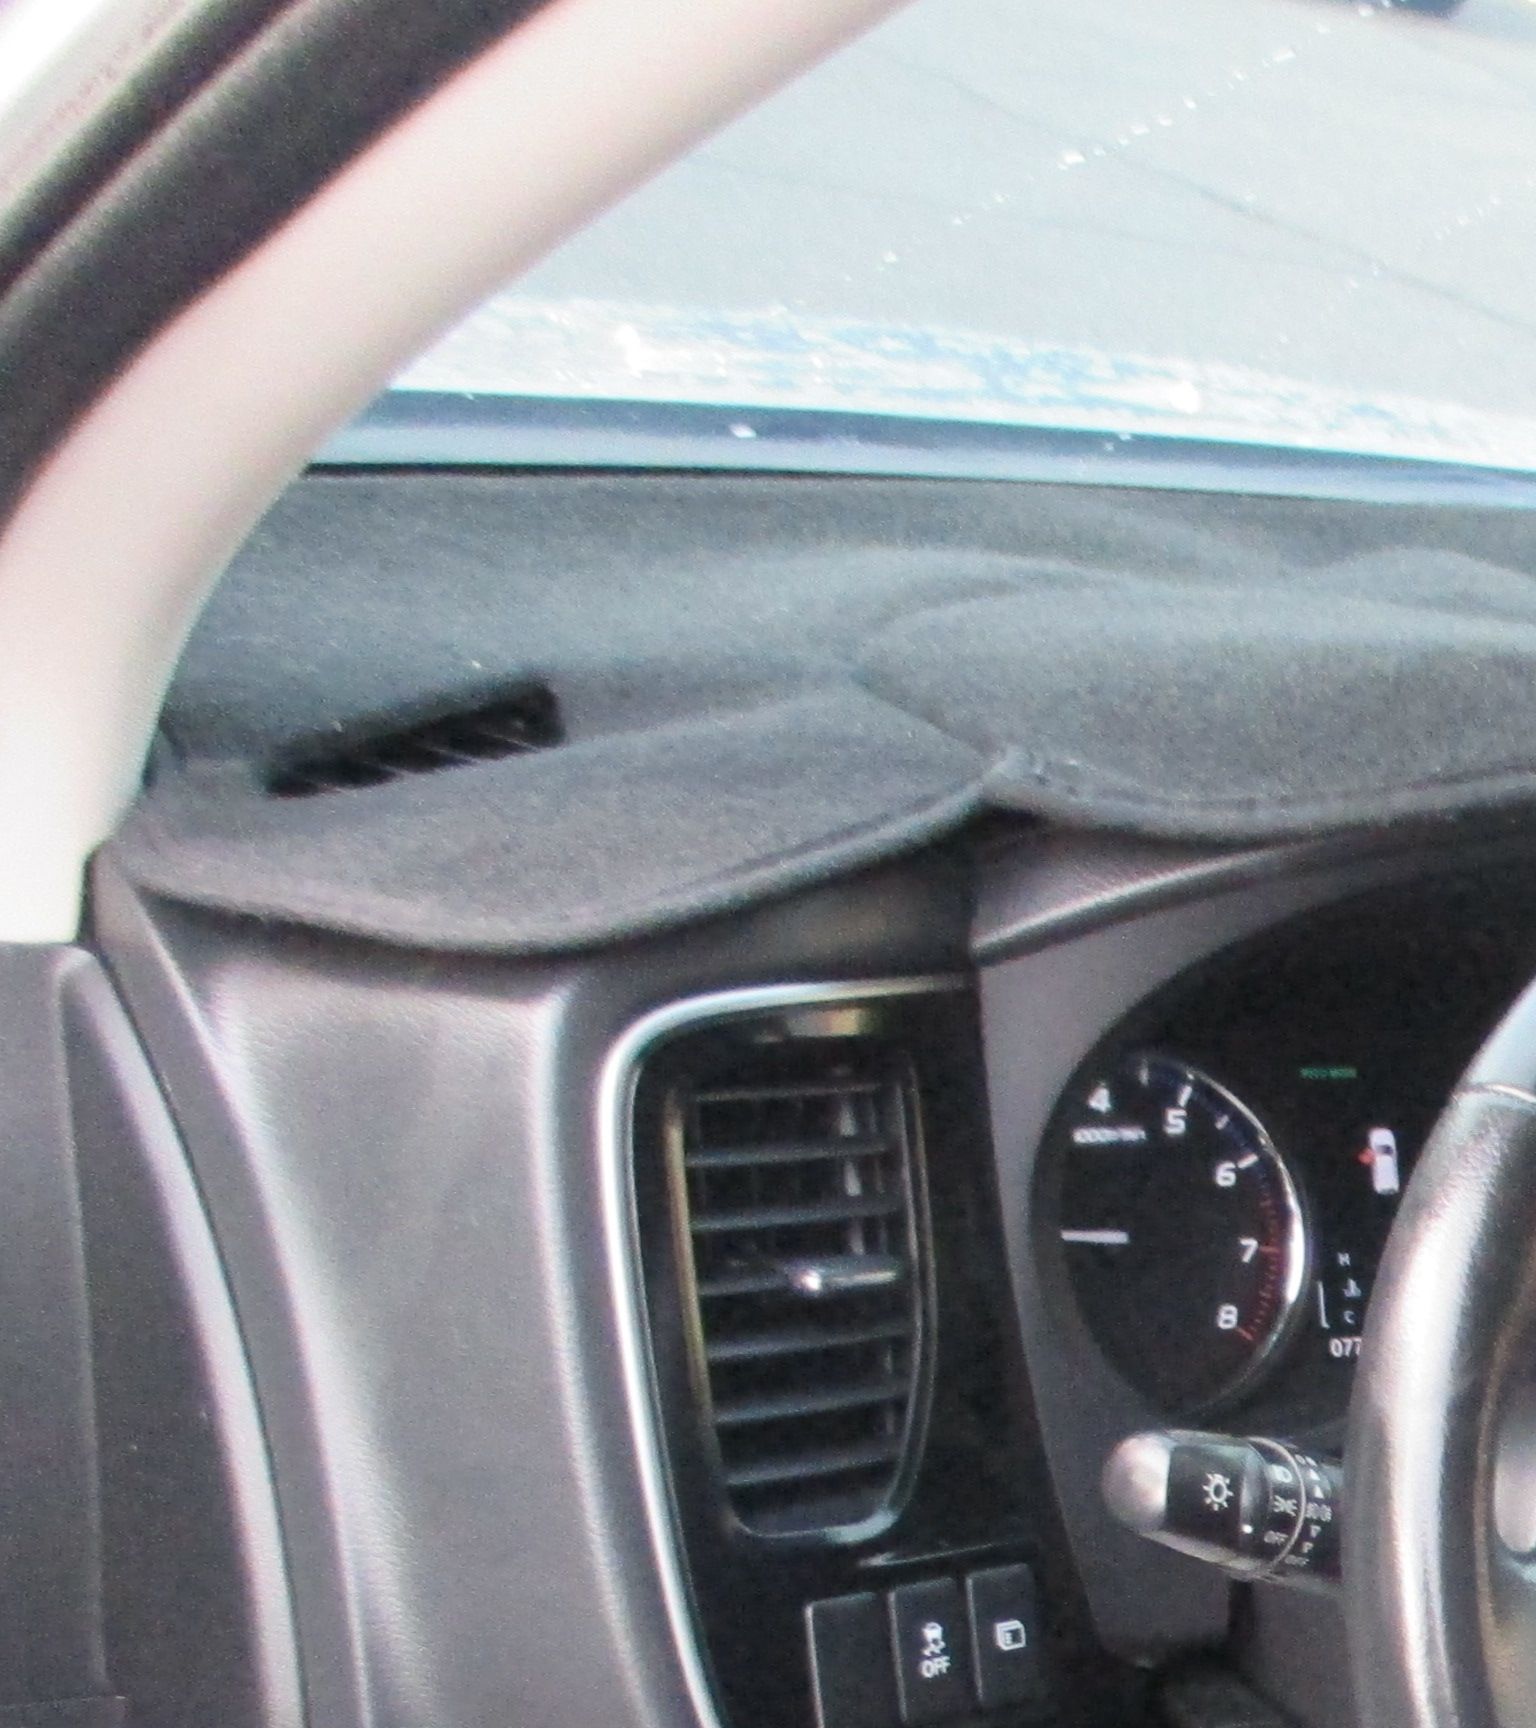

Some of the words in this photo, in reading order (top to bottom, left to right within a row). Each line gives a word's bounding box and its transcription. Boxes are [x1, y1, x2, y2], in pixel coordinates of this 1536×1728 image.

[1087, 1086, 1111, 1113] 4
[1163, 1108, 1187, 1135] 5
[1215, 1163, 1236, 1187] 6
[1239, 1238, 1258, 1263] 7
[1217, 1304, 1238, 1330] 8
[920, 1656, 951, 1679] OFF
